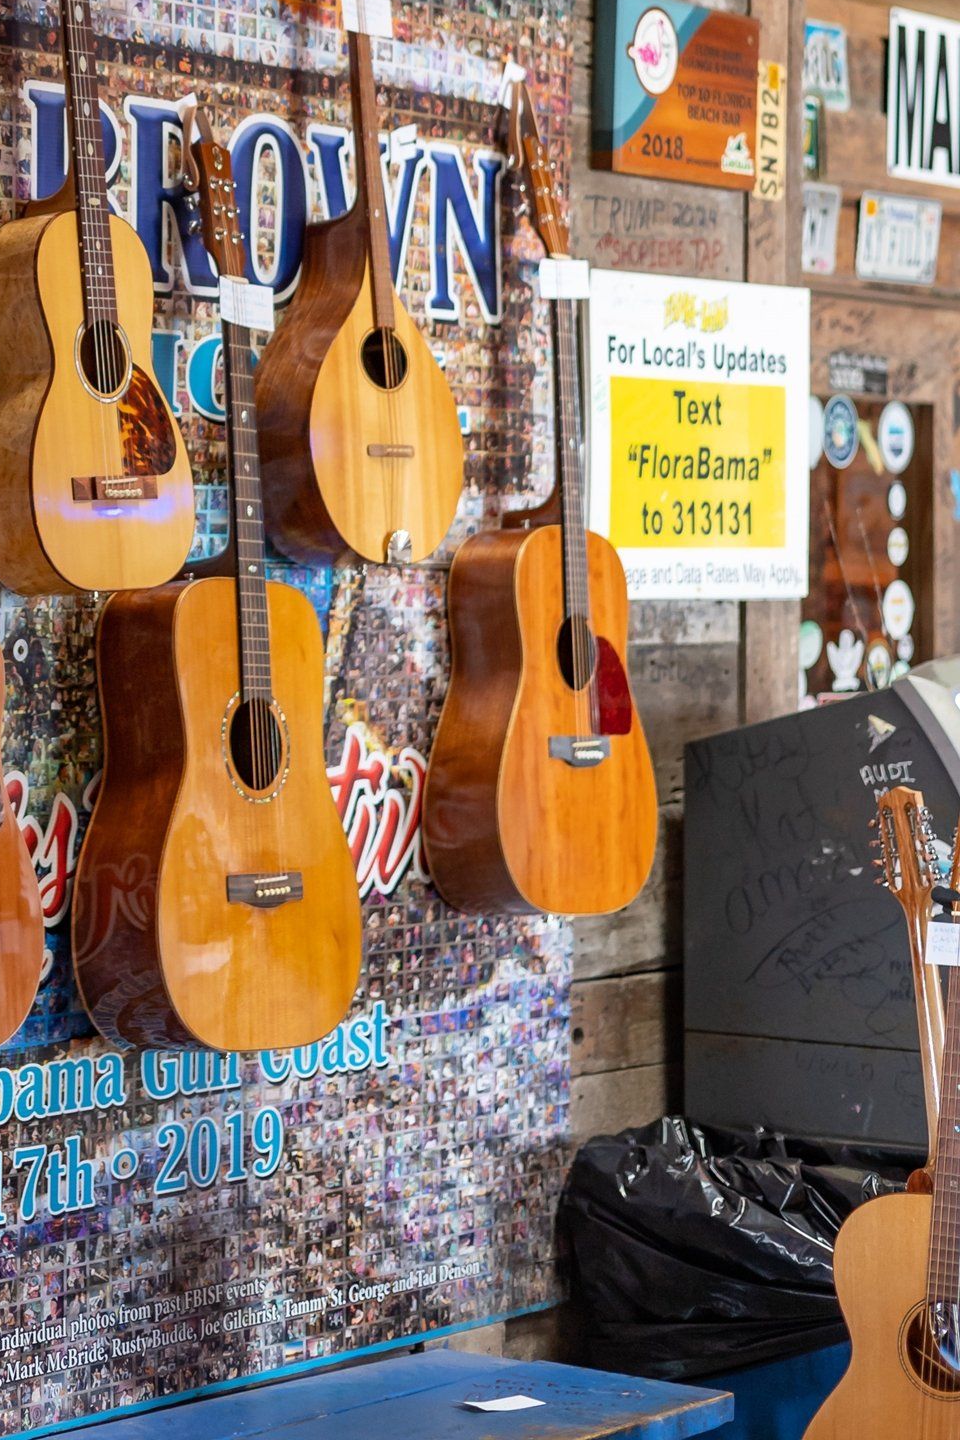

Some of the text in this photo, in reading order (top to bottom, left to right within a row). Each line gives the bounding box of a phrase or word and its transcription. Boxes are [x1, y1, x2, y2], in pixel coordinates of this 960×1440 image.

[677, 82, 753, 110] TOP 10 FLORIDA
[687, 103, 741, 126] BEACH BAR
[641, 132, 684, 160] 2018
[583, 194, 665, 233] TRUMP
[608, 335, 636, 365] For
[642, 337, 705, 369] Local's
[714, 343, 787, 378] Updates
[673, 390, 722, 426] Text
[628, 444, 772, 481] “FloraBama”
[642, 500, 753, 535] to 313131
[651, 563, 672, 584] and
[676, 562, 702, 585] Data
[707, 563, 739, 585] Rates
[743, 563, 765, 587] May
[154, 1104, 285, 1195] 2019
[6, 1356, 45, 1384] Mark
[46, 1339, 109, 1376] McBride,
[111, 1333, 147, 1358] Rusty
[151, 1322, 197, 1349] Budde,
[199, 1321, 221, 1342] Joe
[222, 1304, 280, 1331] Gilchrist,
[283, 1297, 328, 1319] Tammy
[330, 1291, 346, 1309] St.
[348, 1281, 391, 1304] George
[392, 1274, 415, 1294] and
[416, 1269, 437, 1288] Tad
[439, 1261, 480, 1283] Denson
[69, 1307, 116, 1340] photos
[117, 1302, 151, 1326] from
[154, 1298, 182, 1323] past
[184, 1283, 224, 1312] FBISF
[225, 1278, 267, 1302] events
